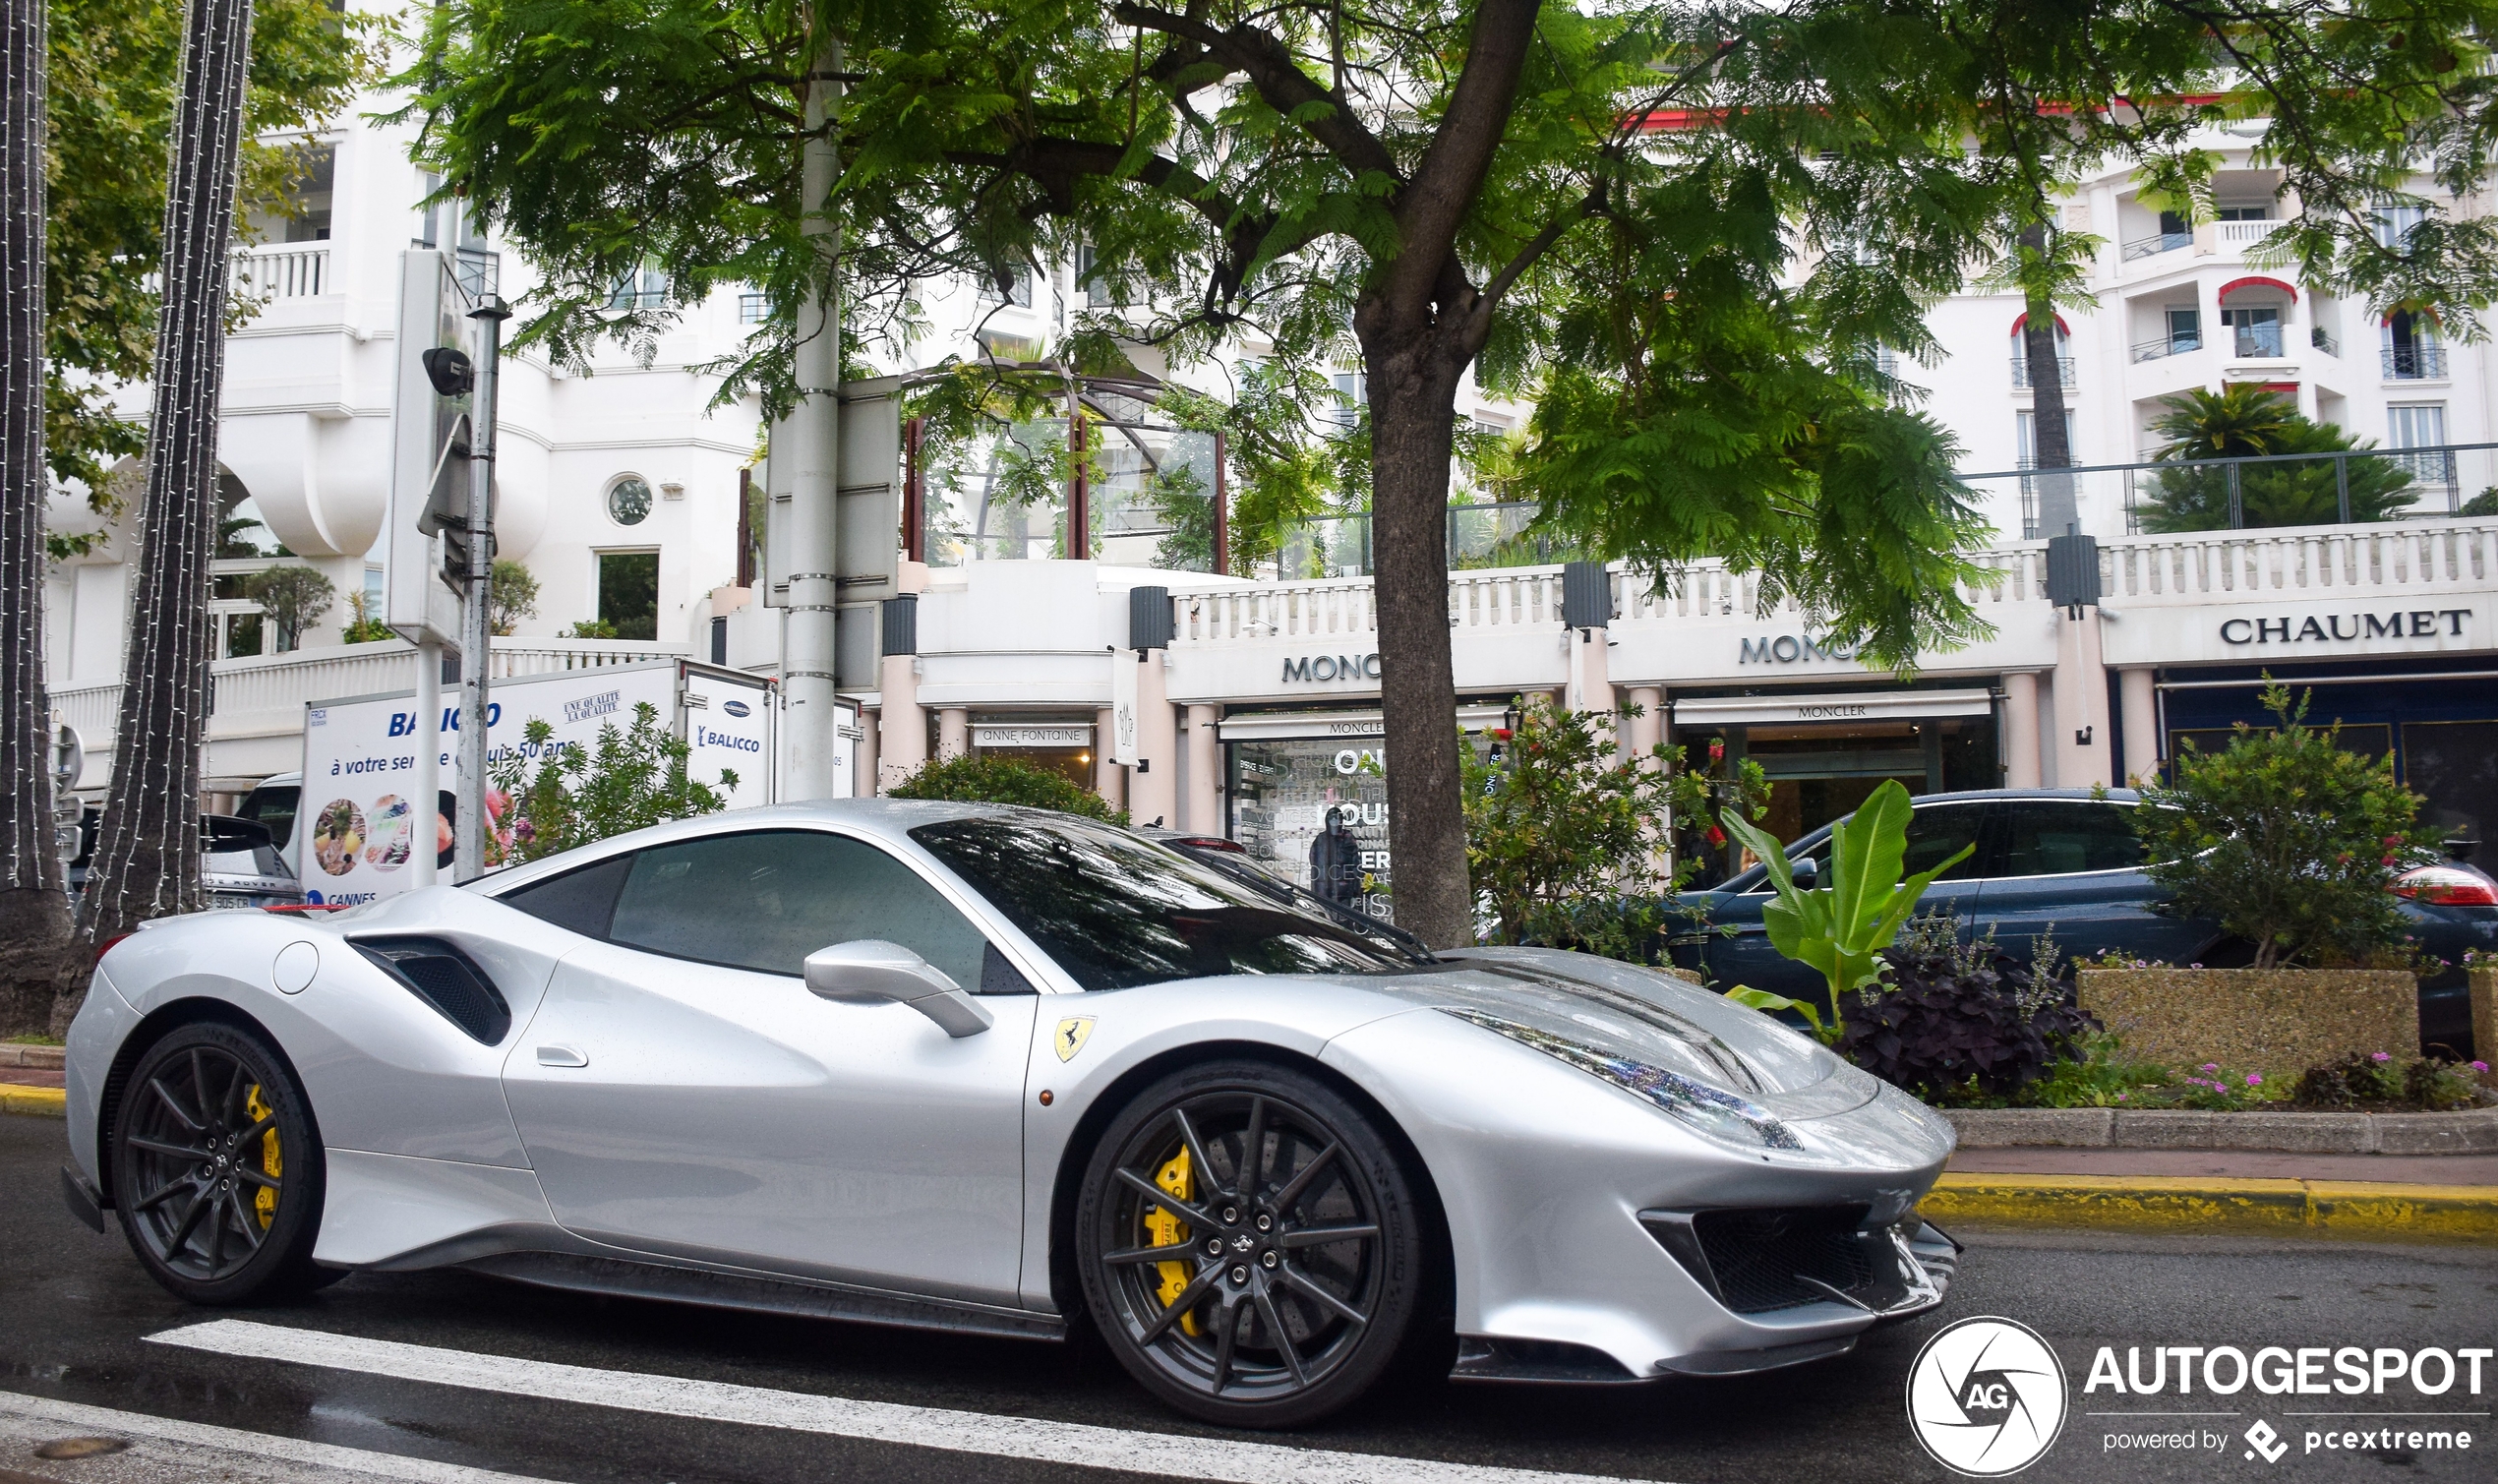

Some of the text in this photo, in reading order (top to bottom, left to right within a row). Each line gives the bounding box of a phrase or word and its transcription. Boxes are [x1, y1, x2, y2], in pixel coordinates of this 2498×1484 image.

[2220, 609, 2472, 645] CHAUMET
[1281, 653, 1382, 683] MONC
[565, 700, 582, 714] UNE
[1798, 705, 1867, 718] MONCLER
[567, 710, 579, 722] LA
[1330, 722, 1386, 734] MONCLE
[707, 732, 760, 753] BALICCO
[331, 758, 340, 776] à
[345, 755, 387, 775] votre
[391, 752, 449, 771] sere
[518, 742, 539, 760] 50
